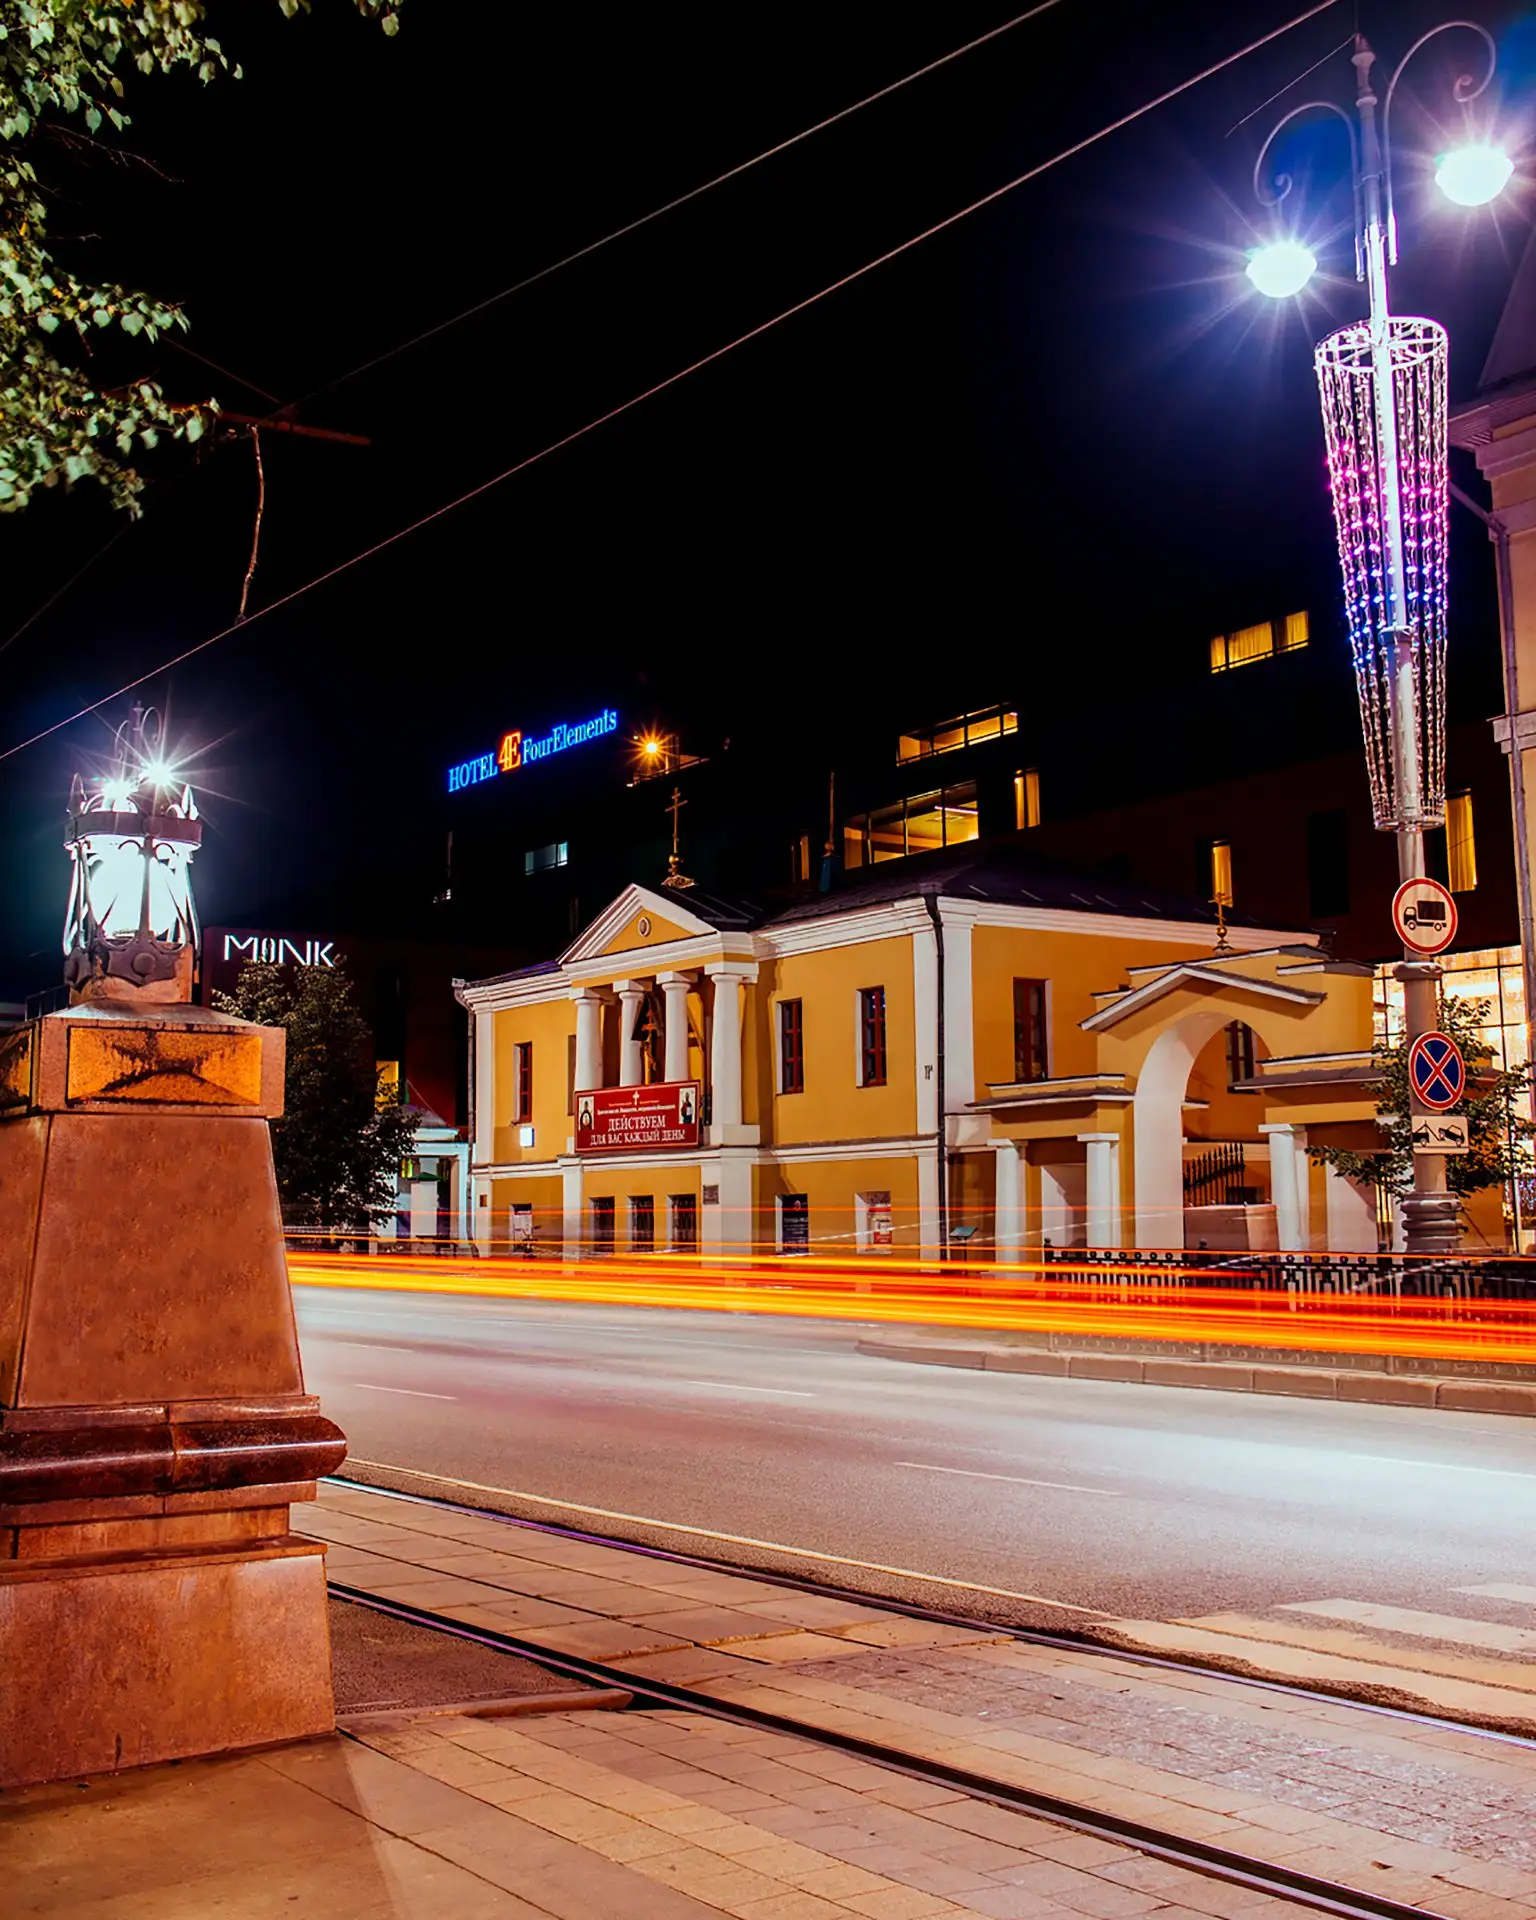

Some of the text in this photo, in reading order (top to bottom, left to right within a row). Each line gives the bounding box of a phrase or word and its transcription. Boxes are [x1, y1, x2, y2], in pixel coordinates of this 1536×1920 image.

[448, 753, 498, 793] HOTEL
[522, 708, 618, 766] FourElements
[224, 934, 335, 968] MONK
[608, 1115, 666, 1132] ДЕЙСТВУЕМ
[590, 1134, 606, 1146] ДЛЯ
[608, 1133, 622, 1144] ВАС
[624, 1129, 660, 1143] КАЖДЫЙ
